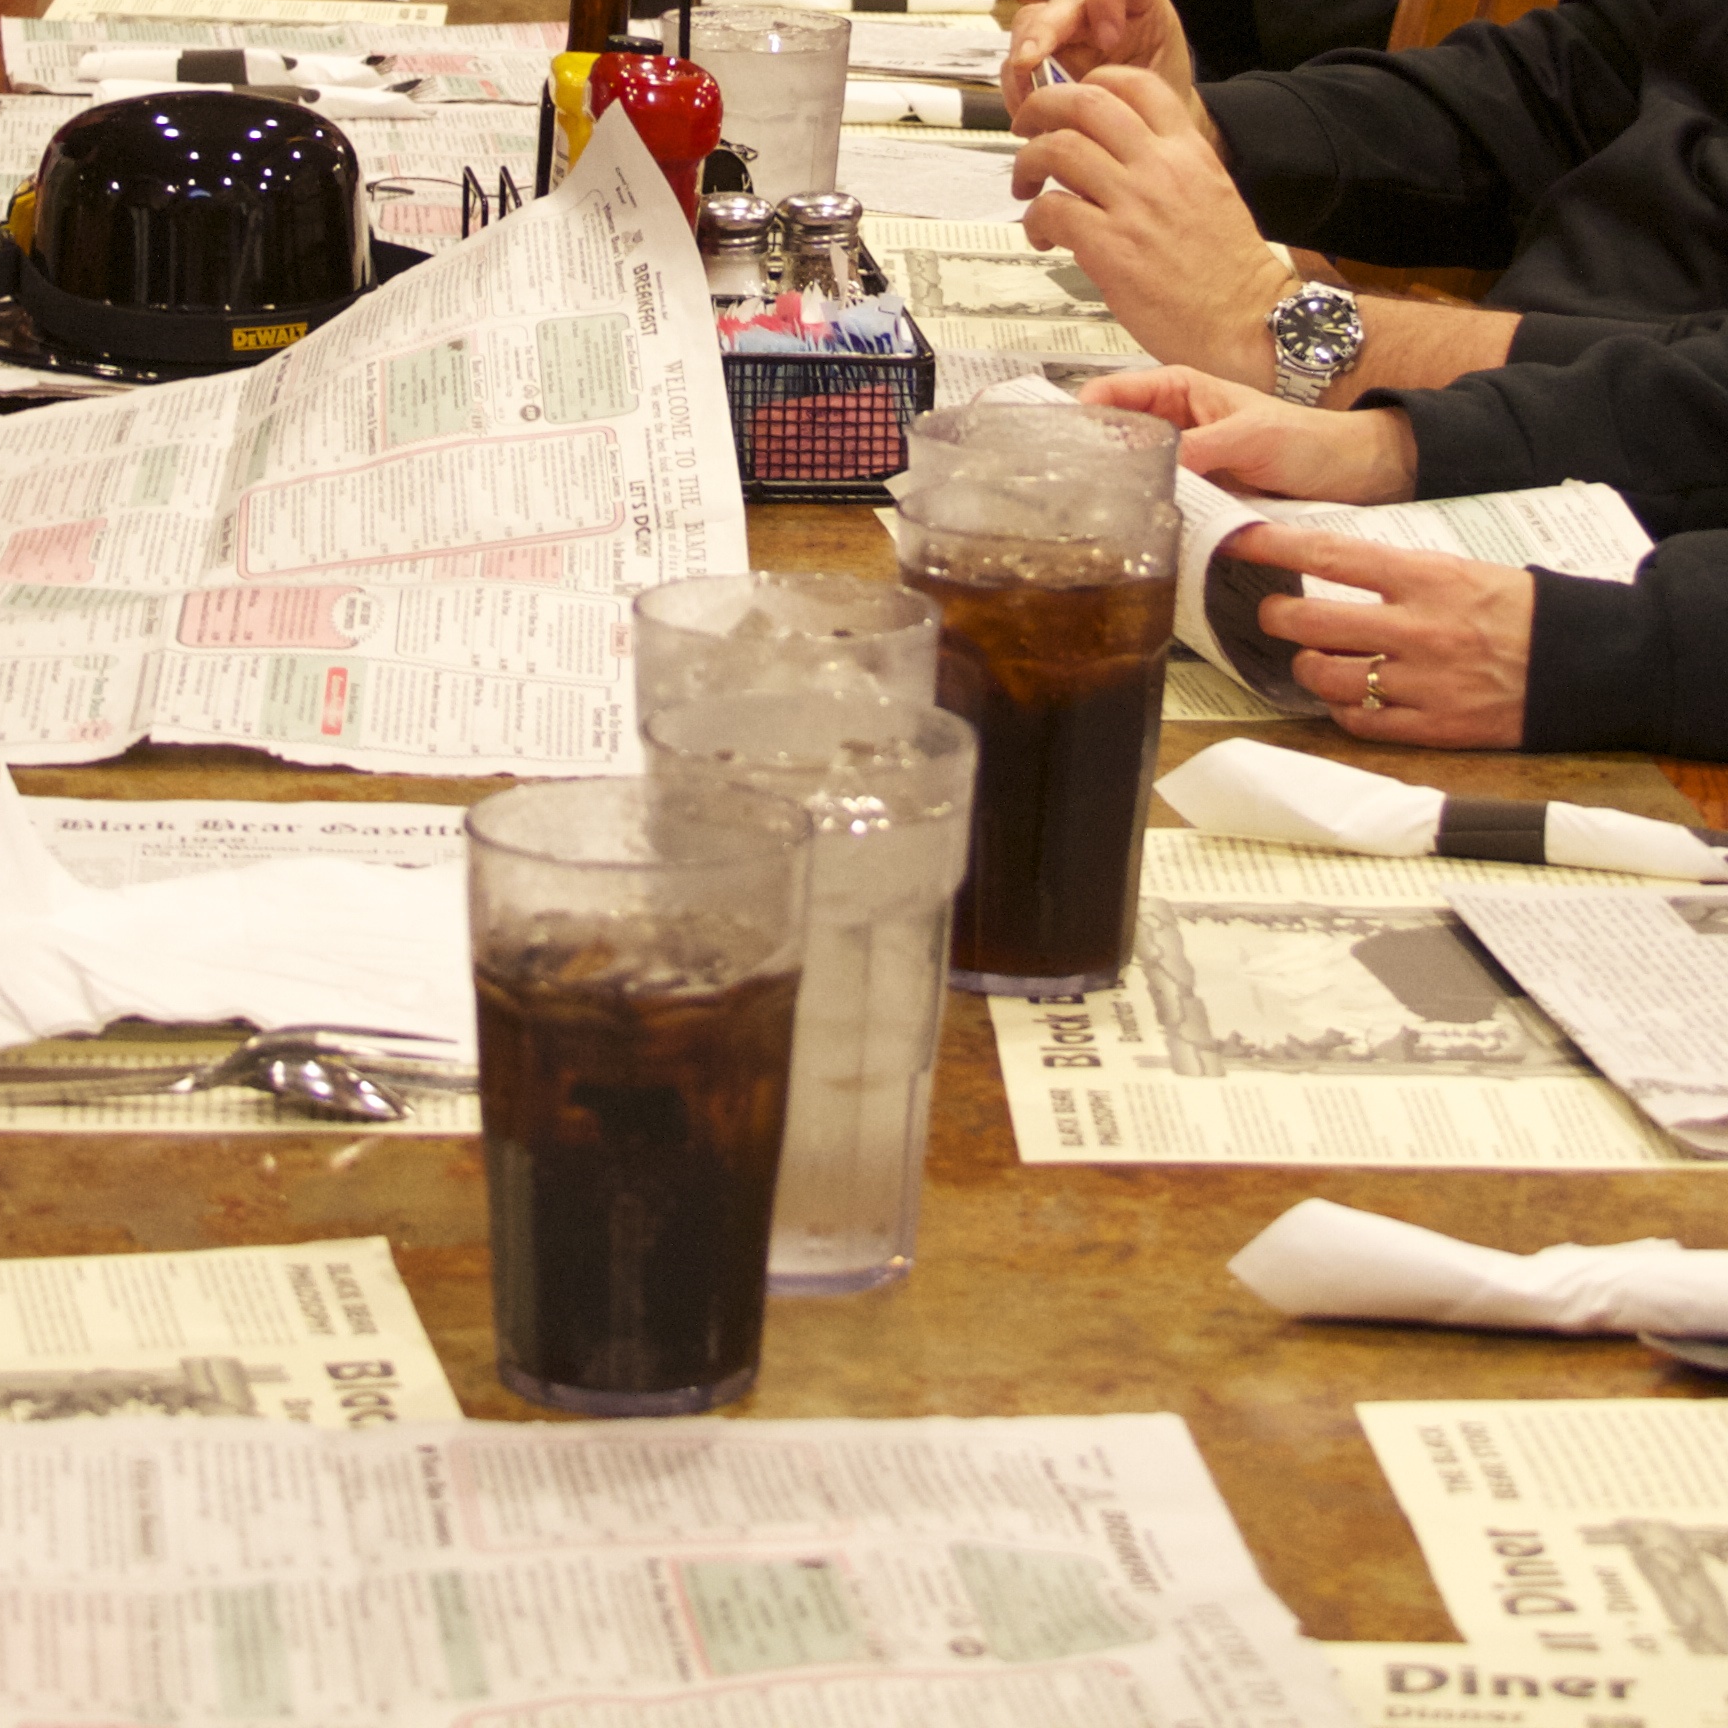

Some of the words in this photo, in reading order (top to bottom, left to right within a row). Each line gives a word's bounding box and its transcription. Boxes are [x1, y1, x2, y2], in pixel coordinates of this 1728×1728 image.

[633, 262, 659, 337] BREAKFAST
[664, 359, 692, 441] WELCOME
[674, 447, 696, 469] TO
[678, 474, 702, 510] THE
[325, 1359, 403, 1430] Blac
[1484, 1526, 1579, 1617] Diner
[1384, 1661, 1639, 1700] Diner
